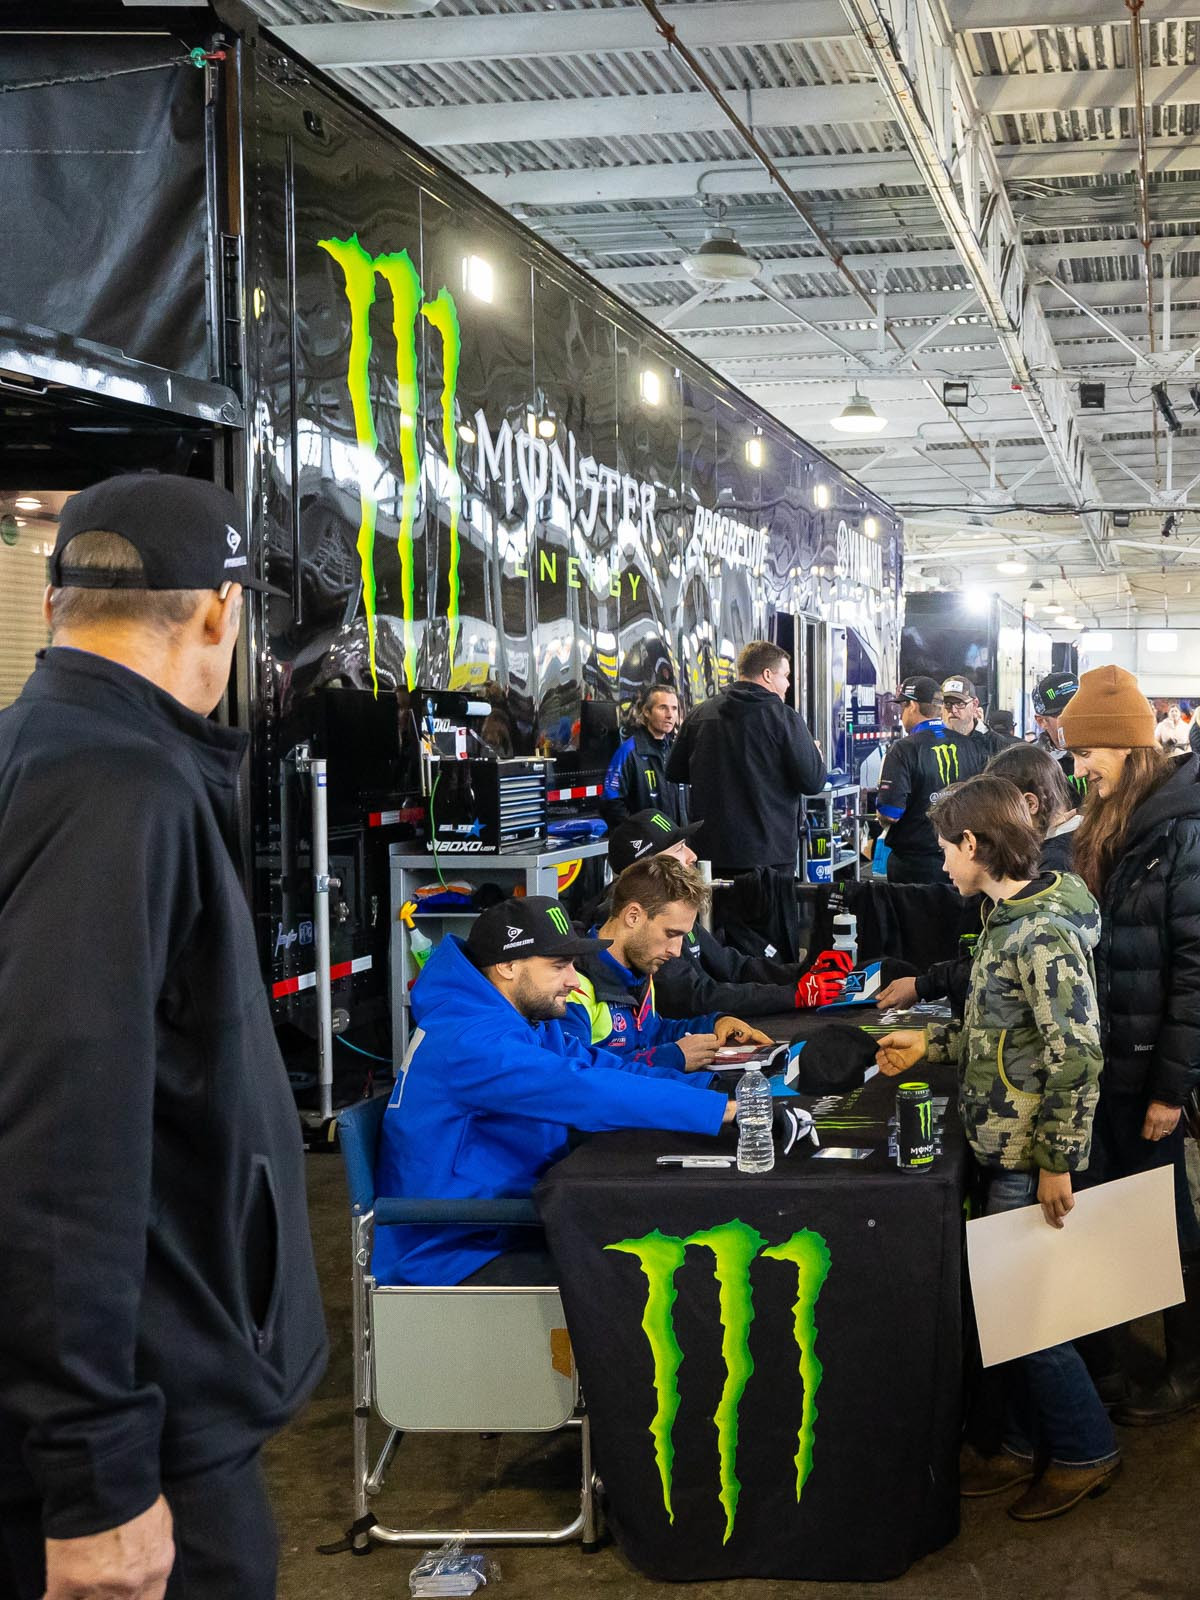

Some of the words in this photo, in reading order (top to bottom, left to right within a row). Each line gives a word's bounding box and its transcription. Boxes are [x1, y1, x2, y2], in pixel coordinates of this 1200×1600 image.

[473, 407, 661, 549] MONSTER
[514, 547, 641, 600] ENEGY
[438, 841, 483, 852] BOXO
